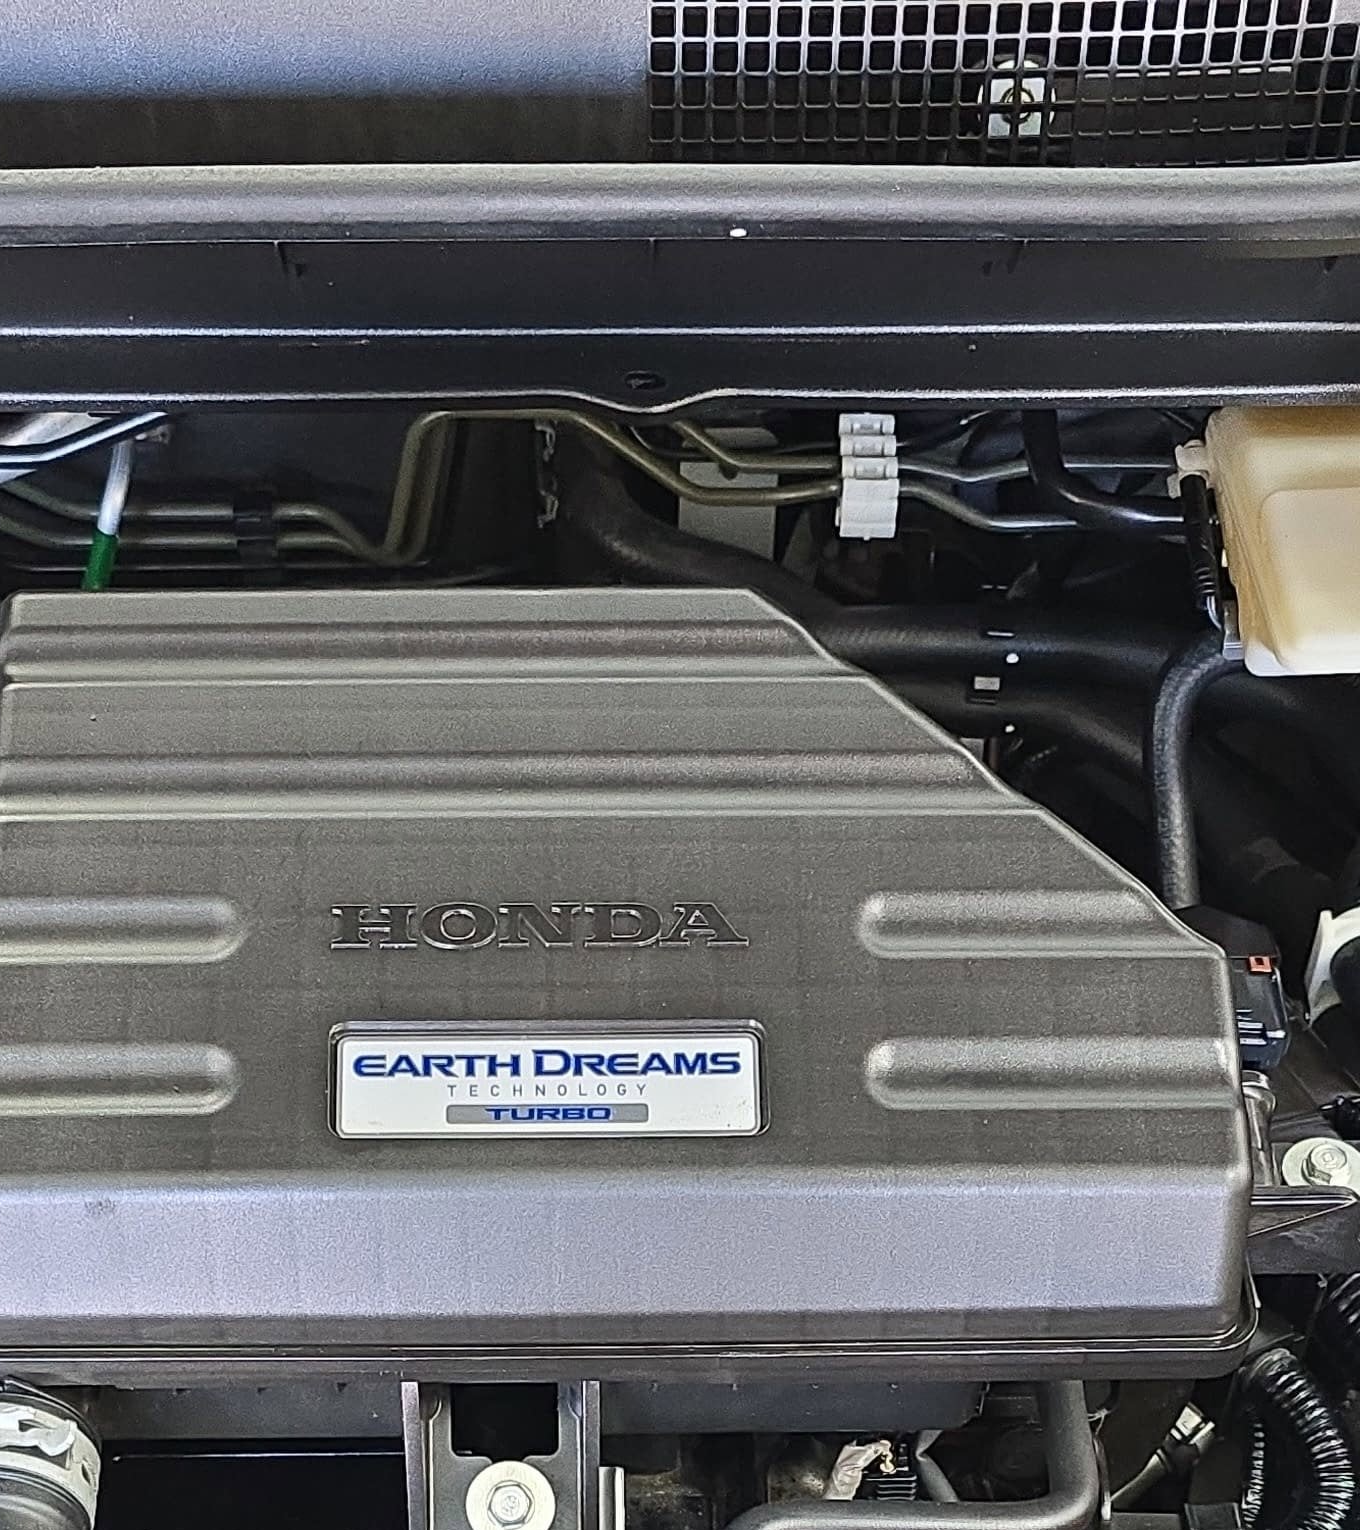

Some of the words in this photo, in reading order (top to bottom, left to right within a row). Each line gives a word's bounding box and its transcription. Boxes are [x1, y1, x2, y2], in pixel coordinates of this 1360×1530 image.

[330, 902, 749, 950] HONDA
[353, 1054, 521, 1077] EARTH
[533, 1049, 741, 1077] DREAMS
[447, 1084, 648, 1097] TECHNOLOGY
[485, 1107, 611, 1121] TURBO
